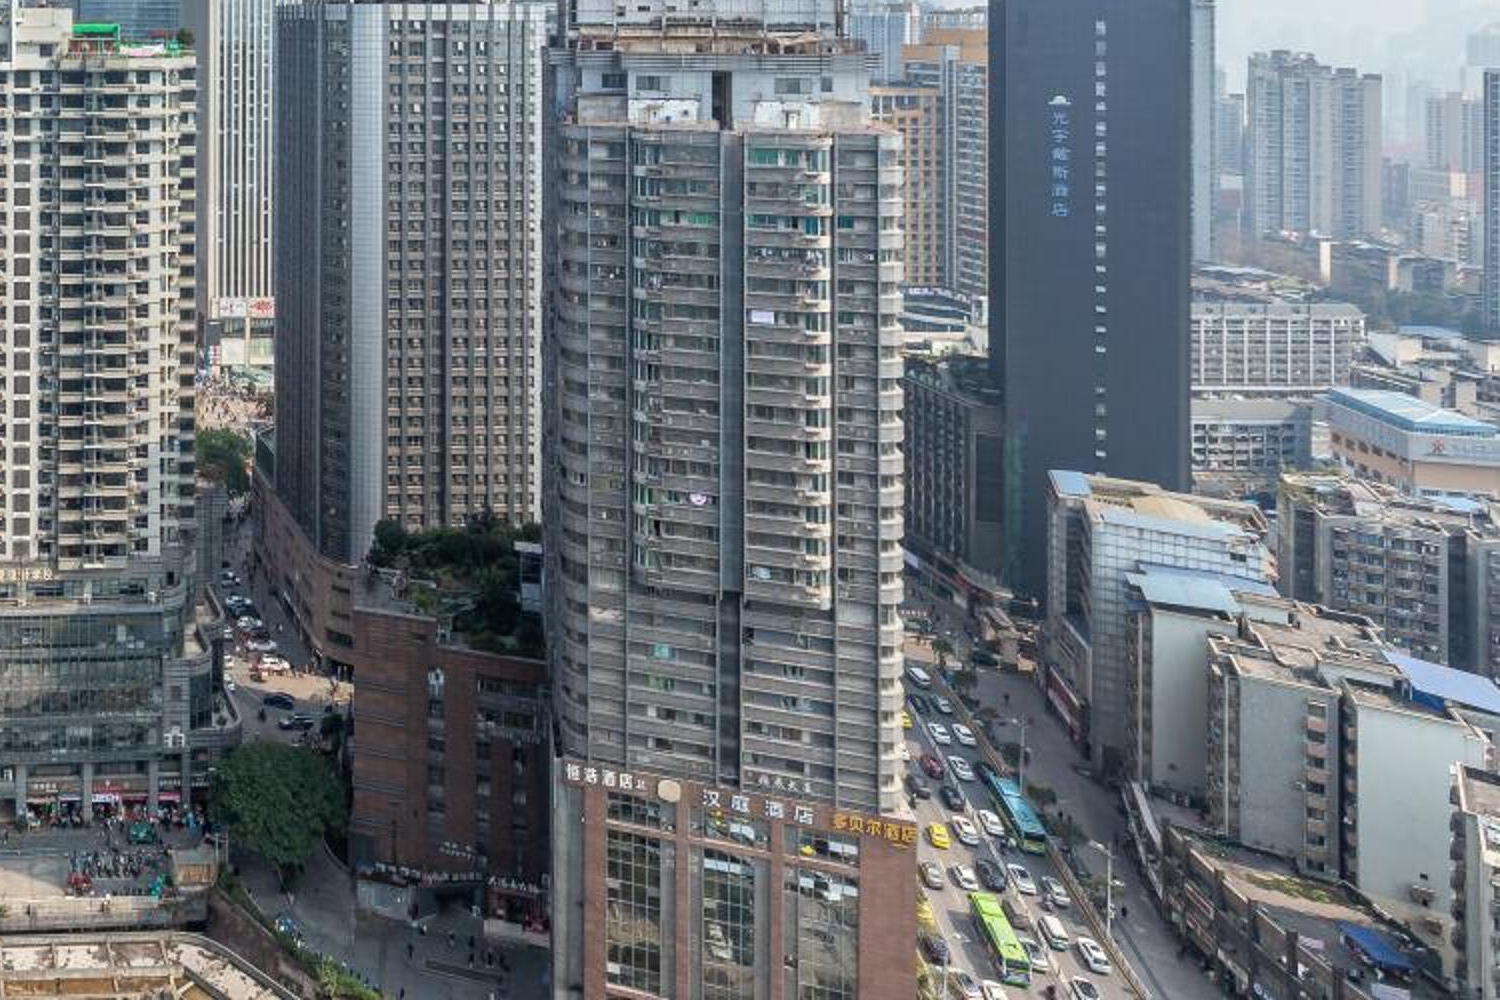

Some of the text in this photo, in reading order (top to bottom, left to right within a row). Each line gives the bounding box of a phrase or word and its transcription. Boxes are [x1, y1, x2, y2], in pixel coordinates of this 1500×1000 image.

[702, 788, 814, 825] 汉庭酒店
[833, 812, 917, 843] 多贝尔酒店
